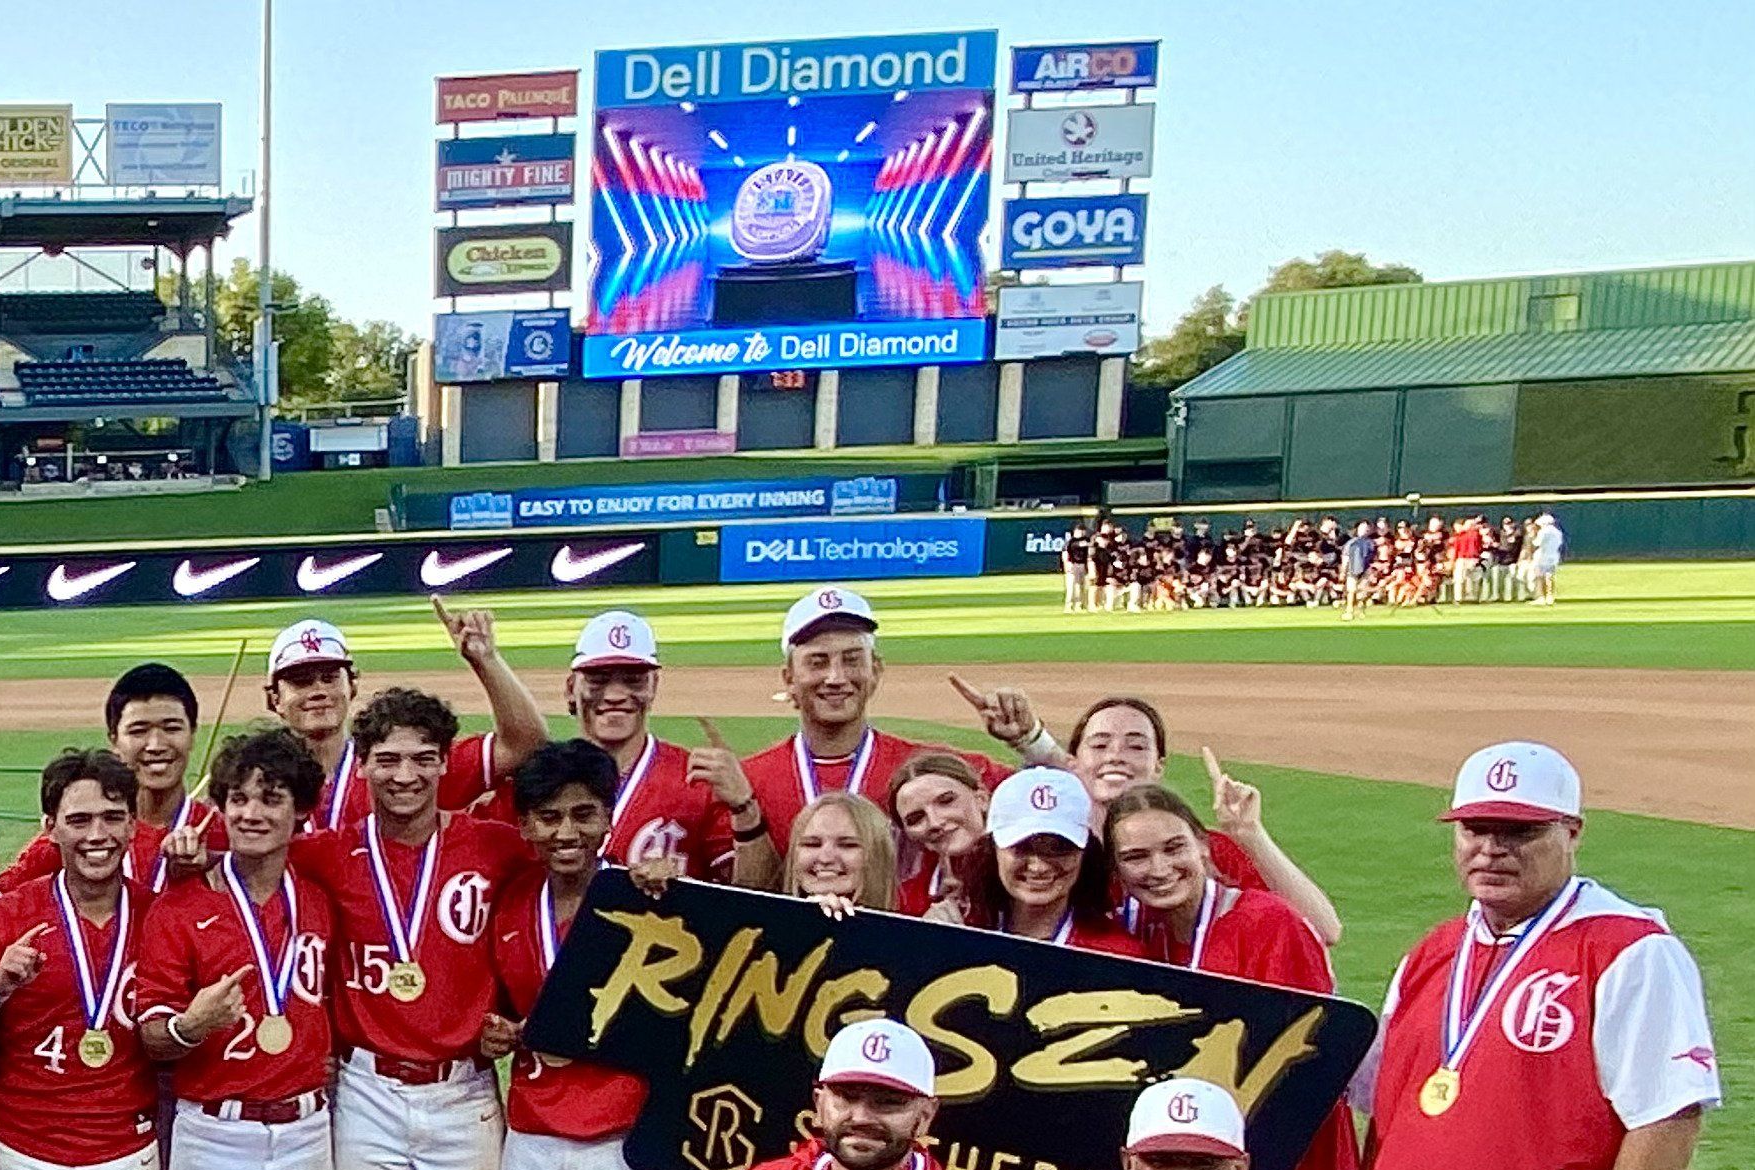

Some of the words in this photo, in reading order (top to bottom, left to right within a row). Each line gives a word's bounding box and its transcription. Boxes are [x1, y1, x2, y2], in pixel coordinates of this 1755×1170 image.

[625, 50, 721, 100] Dell
[741, 37, 968, 94] Diamond
[443, 92, 491, 111] TACO
[1012, 150, 1066, 167] United
[1070, 148, 1144, 166] Heritage
[447, 166, 515, 190] MIGHTY
[523, 164, 567, 185] FINE
[1011, 207, 1136, 249] GOYA
[465, 244, 547, 263] Chicken
[611, 335, 738, 370] Welcome
[743, 331, 773, 362] to
[780, 333, 831, 361] Dell
[839, 329, 958, 361] Diamond
[519, 500, 566, 517] EASY
[567, 499, 593, 515] TO
[596, 496, 653, 514] ENJOY
[656, 494, 695, 512] FOR
[697, 492, 756, 509] EVERY
[758, 489, 825, 508] INNING
[746, 538, 816, 563] DELL
[813, 535, 959, 565] Technologies
[346, 941, 390, 995] 15
[33, 1025, 67, 1075] 4
[223, 1012, 257, 1061] 2
